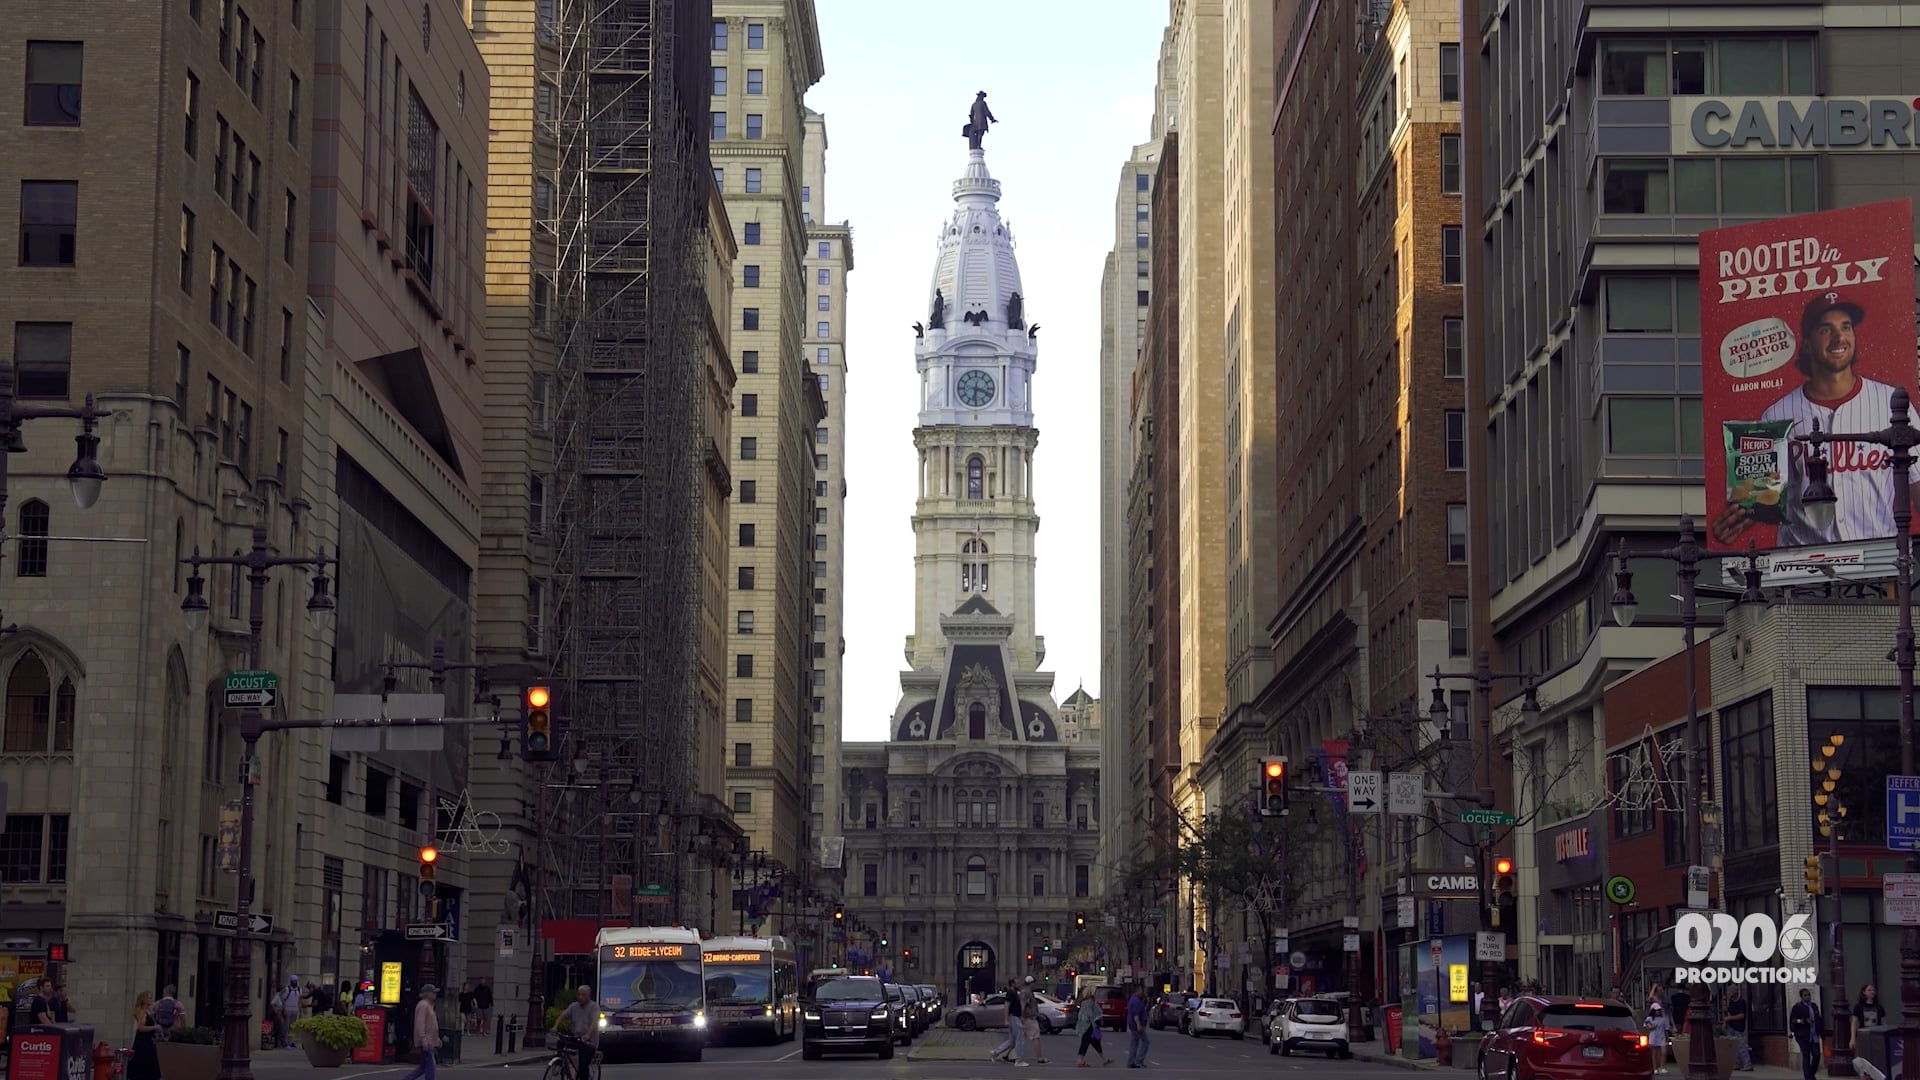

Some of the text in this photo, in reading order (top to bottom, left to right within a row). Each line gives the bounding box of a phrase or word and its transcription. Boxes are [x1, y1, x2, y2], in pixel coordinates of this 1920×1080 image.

[1719, 237, 1841, 278] ROOTED in
[1718, 256, 1890, 304] PHILLY
[1729, 331, 1787, 356] ROOTED
[1738, 341, 1789, 363] FLAVOR
[1739, 453, 1773, 467] SOUR
[1735, 462, 1777, 477] CREAM
[226, 677, 277, 689] LOCUST ST
[230, 694, 262, 702] ONE WAY
[1354, 775, 1375, 785] ONE
[1353, 786, 1376, 796] WAY
[1461, 813, 1503, 824] LOCUST
[220, 915, 236, 926] ONE
[423, 927, 435, 935] WAY
[614, 946, 682, 958] 32 RIDGE-LYCEUM
[1489, 950, 1503, 958] RED
[703, 953, 713, 963] 32
[20, 1041, 52, 1051] Curtis
